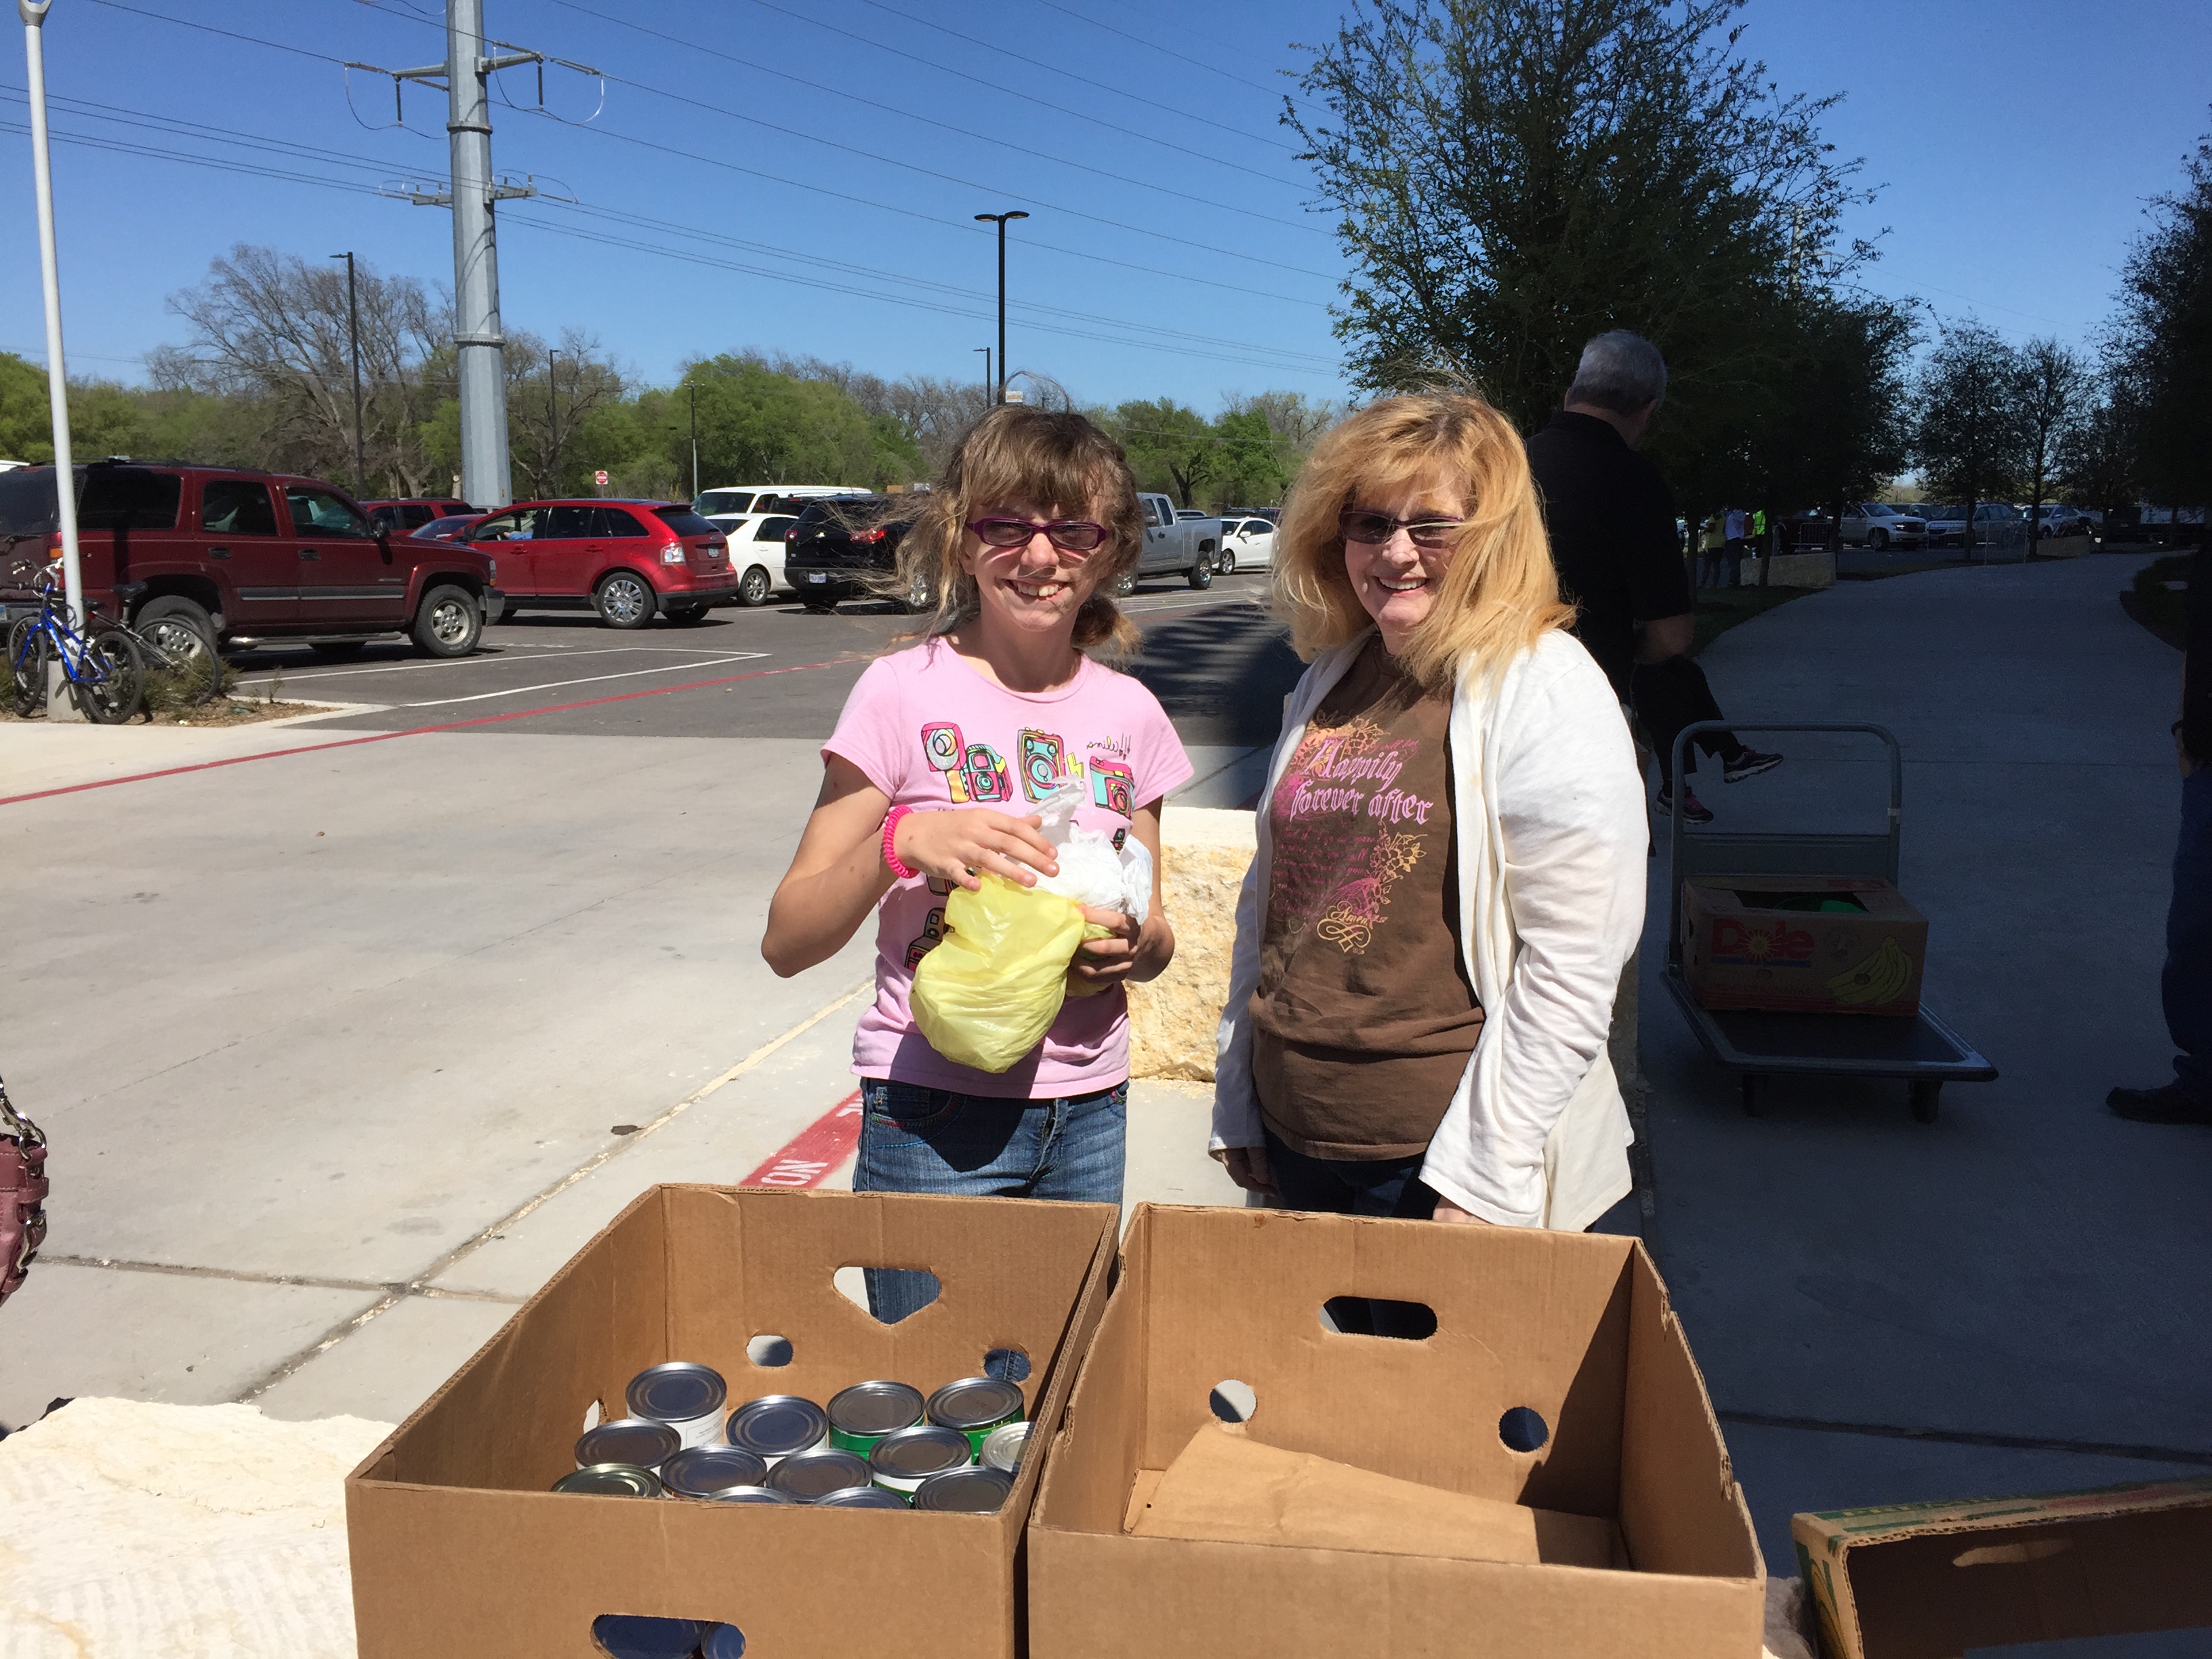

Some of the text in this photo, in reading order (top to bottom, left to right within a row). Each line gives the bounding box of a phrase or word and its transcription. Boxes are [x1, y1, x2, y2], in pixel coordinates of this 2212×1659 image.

[1300, 737, 1403, 792] Happily
[1289, 779, 1434, 825] forever after
[1711, 918, 1815, 961] Dole
